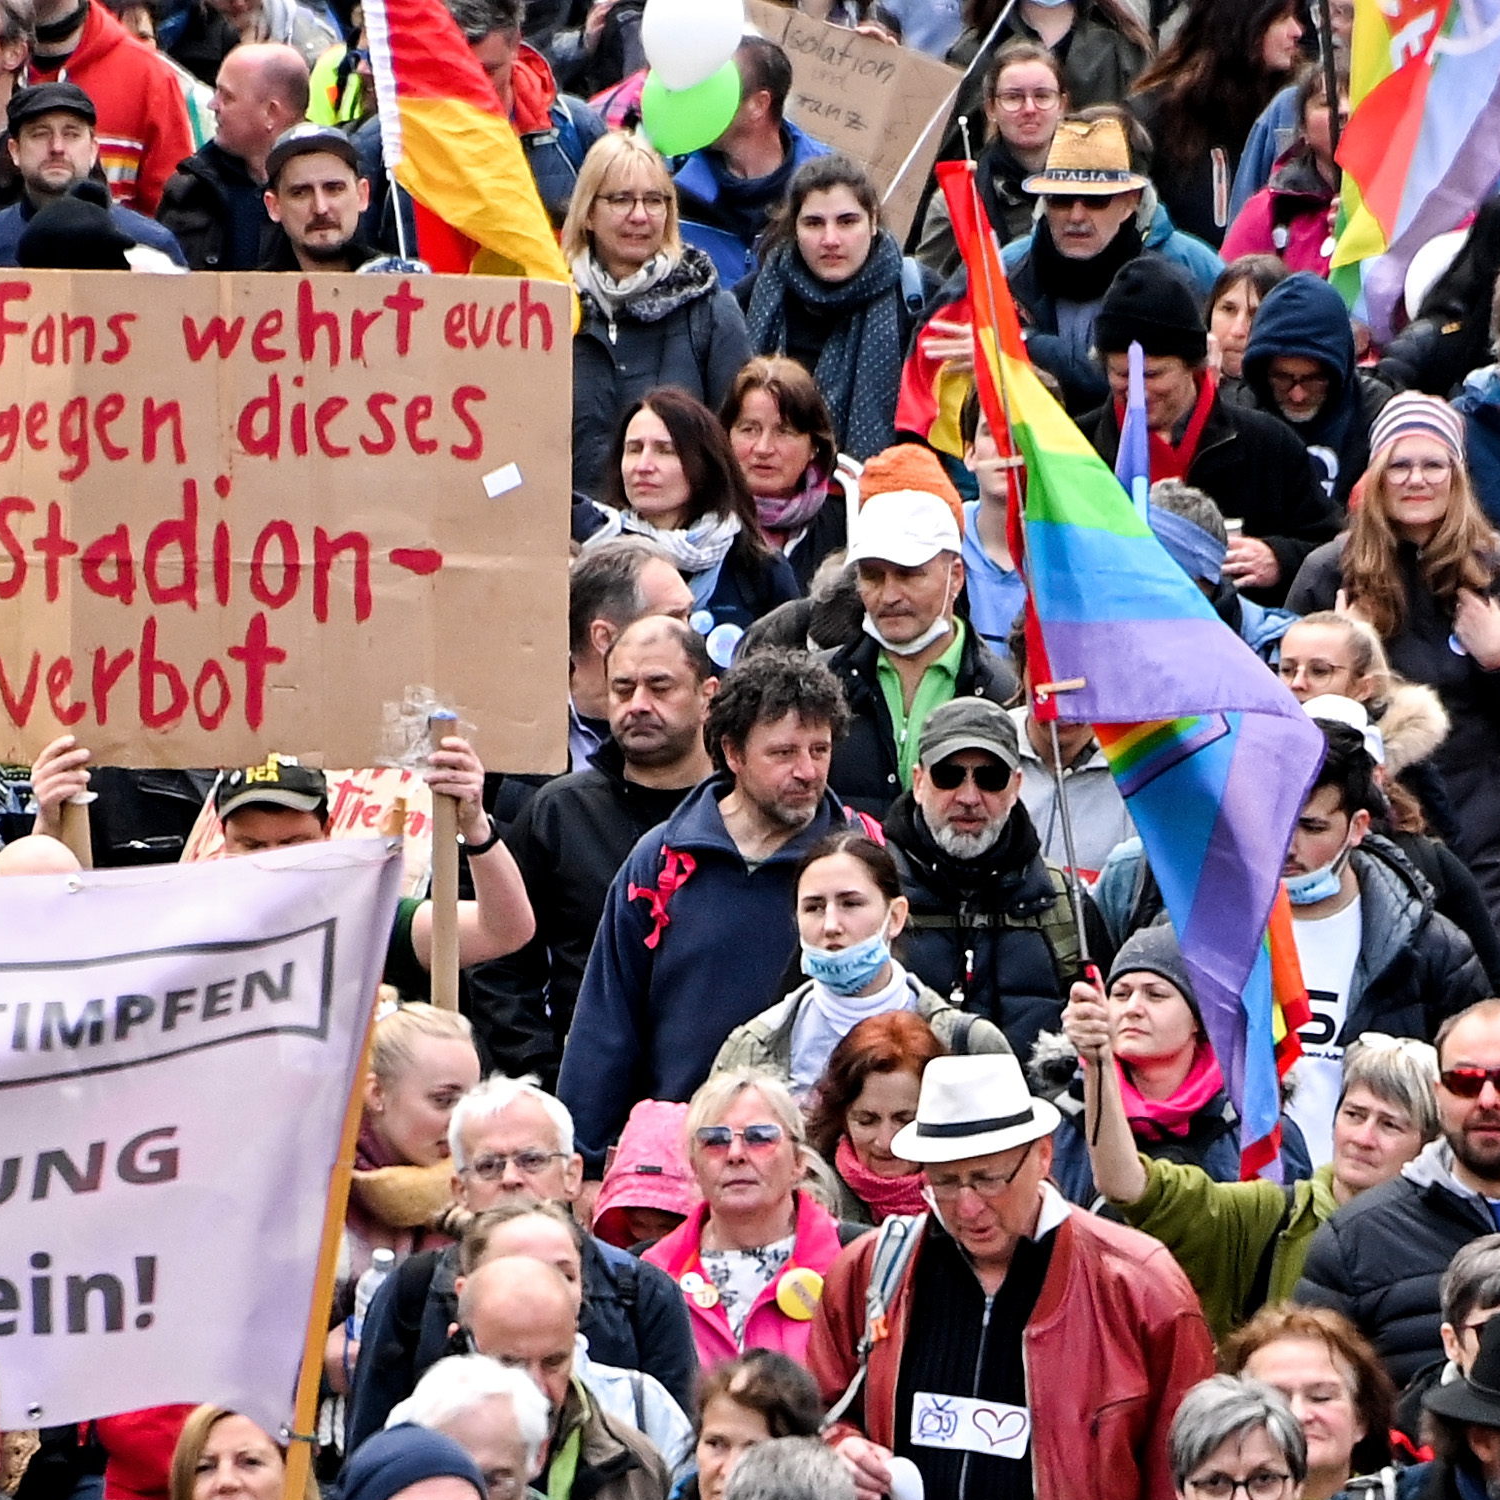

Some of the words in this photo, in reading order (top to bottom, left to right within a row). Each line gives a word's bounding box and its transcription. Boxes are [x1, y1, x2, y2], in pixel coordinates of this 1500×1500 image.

[1051, 170, 1108, 183] ITALIA
[182, 279, 426, 368] wehrt
[444, 280, 555, 352] euch
[237, 373, 488, 462] dieses
